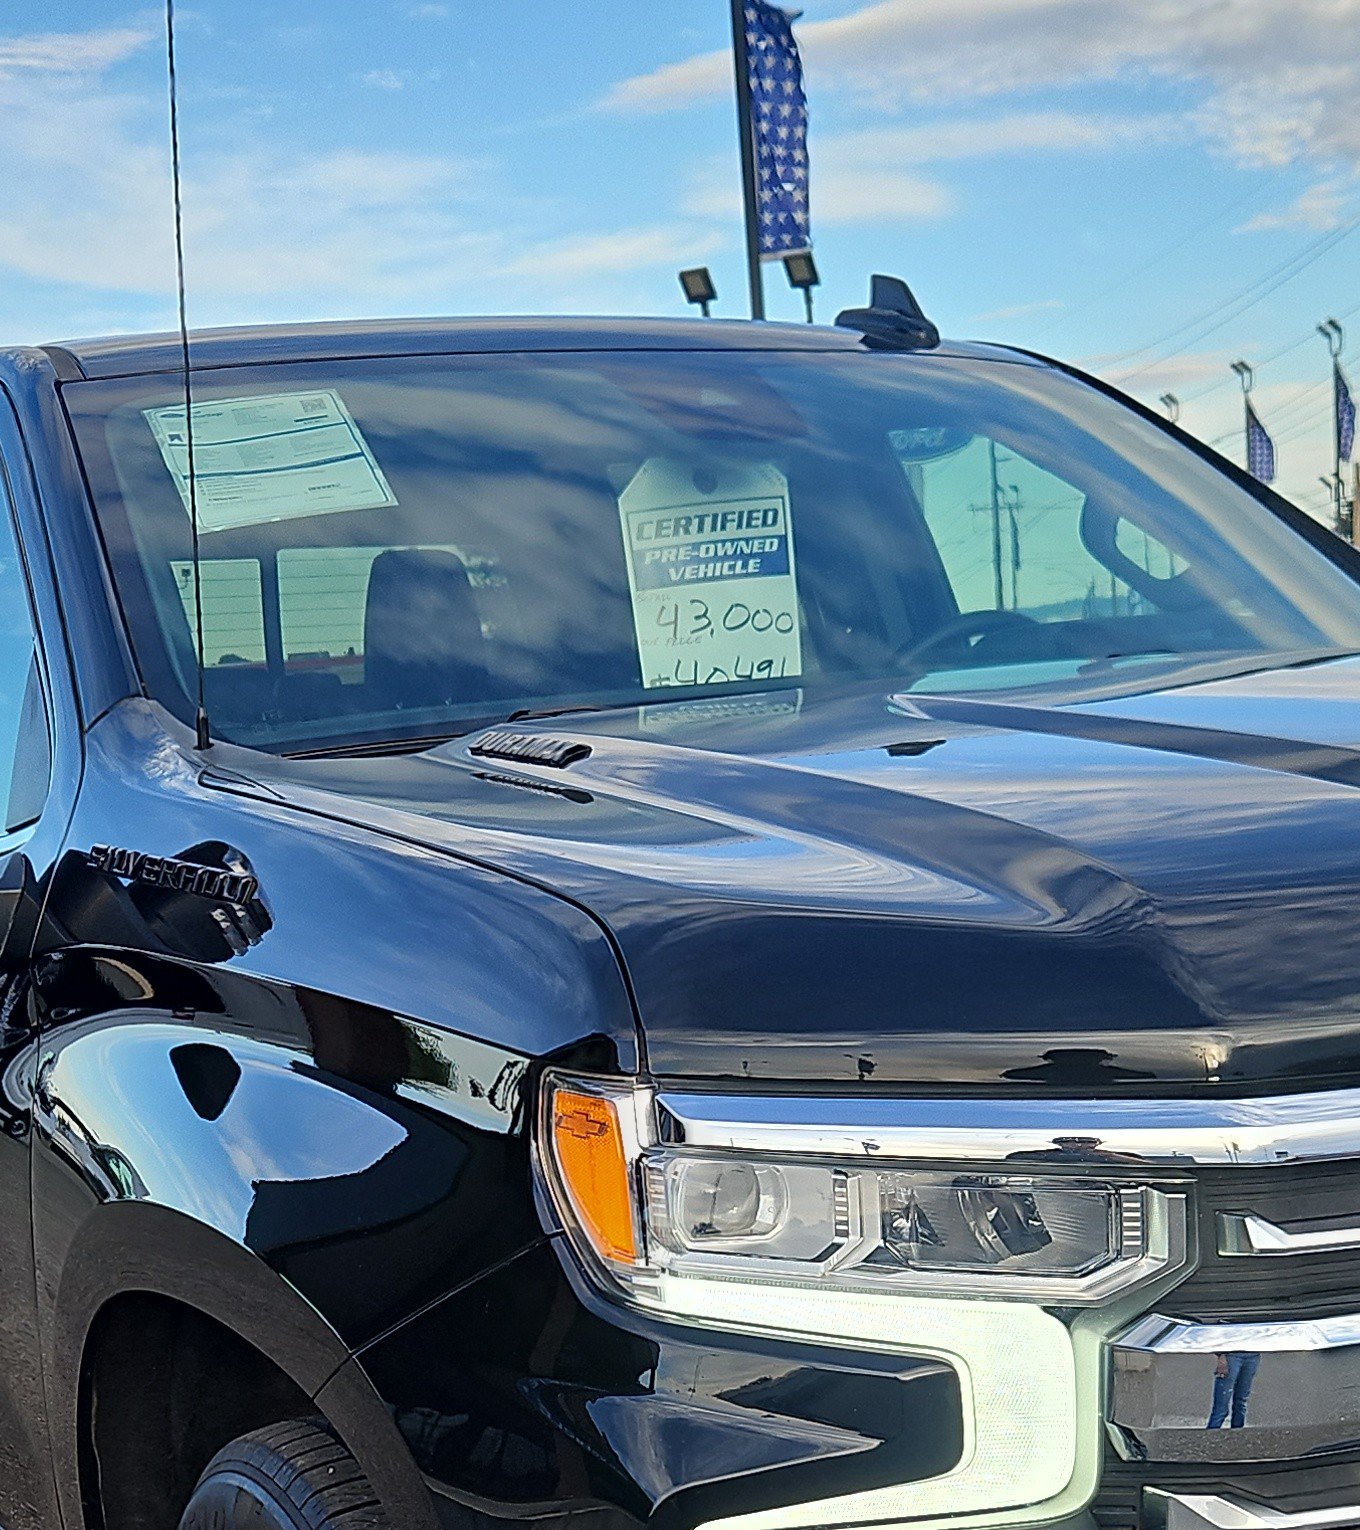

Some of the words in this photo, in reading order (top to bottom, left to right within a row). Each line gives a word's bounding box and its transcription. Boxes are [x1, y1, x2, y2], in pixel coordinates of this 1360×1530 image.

[635, 508, 779, 541] CERTIFIED
[644, 538, 779, 565] PRE-OWNED
[667, 559, 761, 581] VEHICLE
[656, 599, 794, 639] 43,000
[468, 731, 579, 762] DURAMAX
